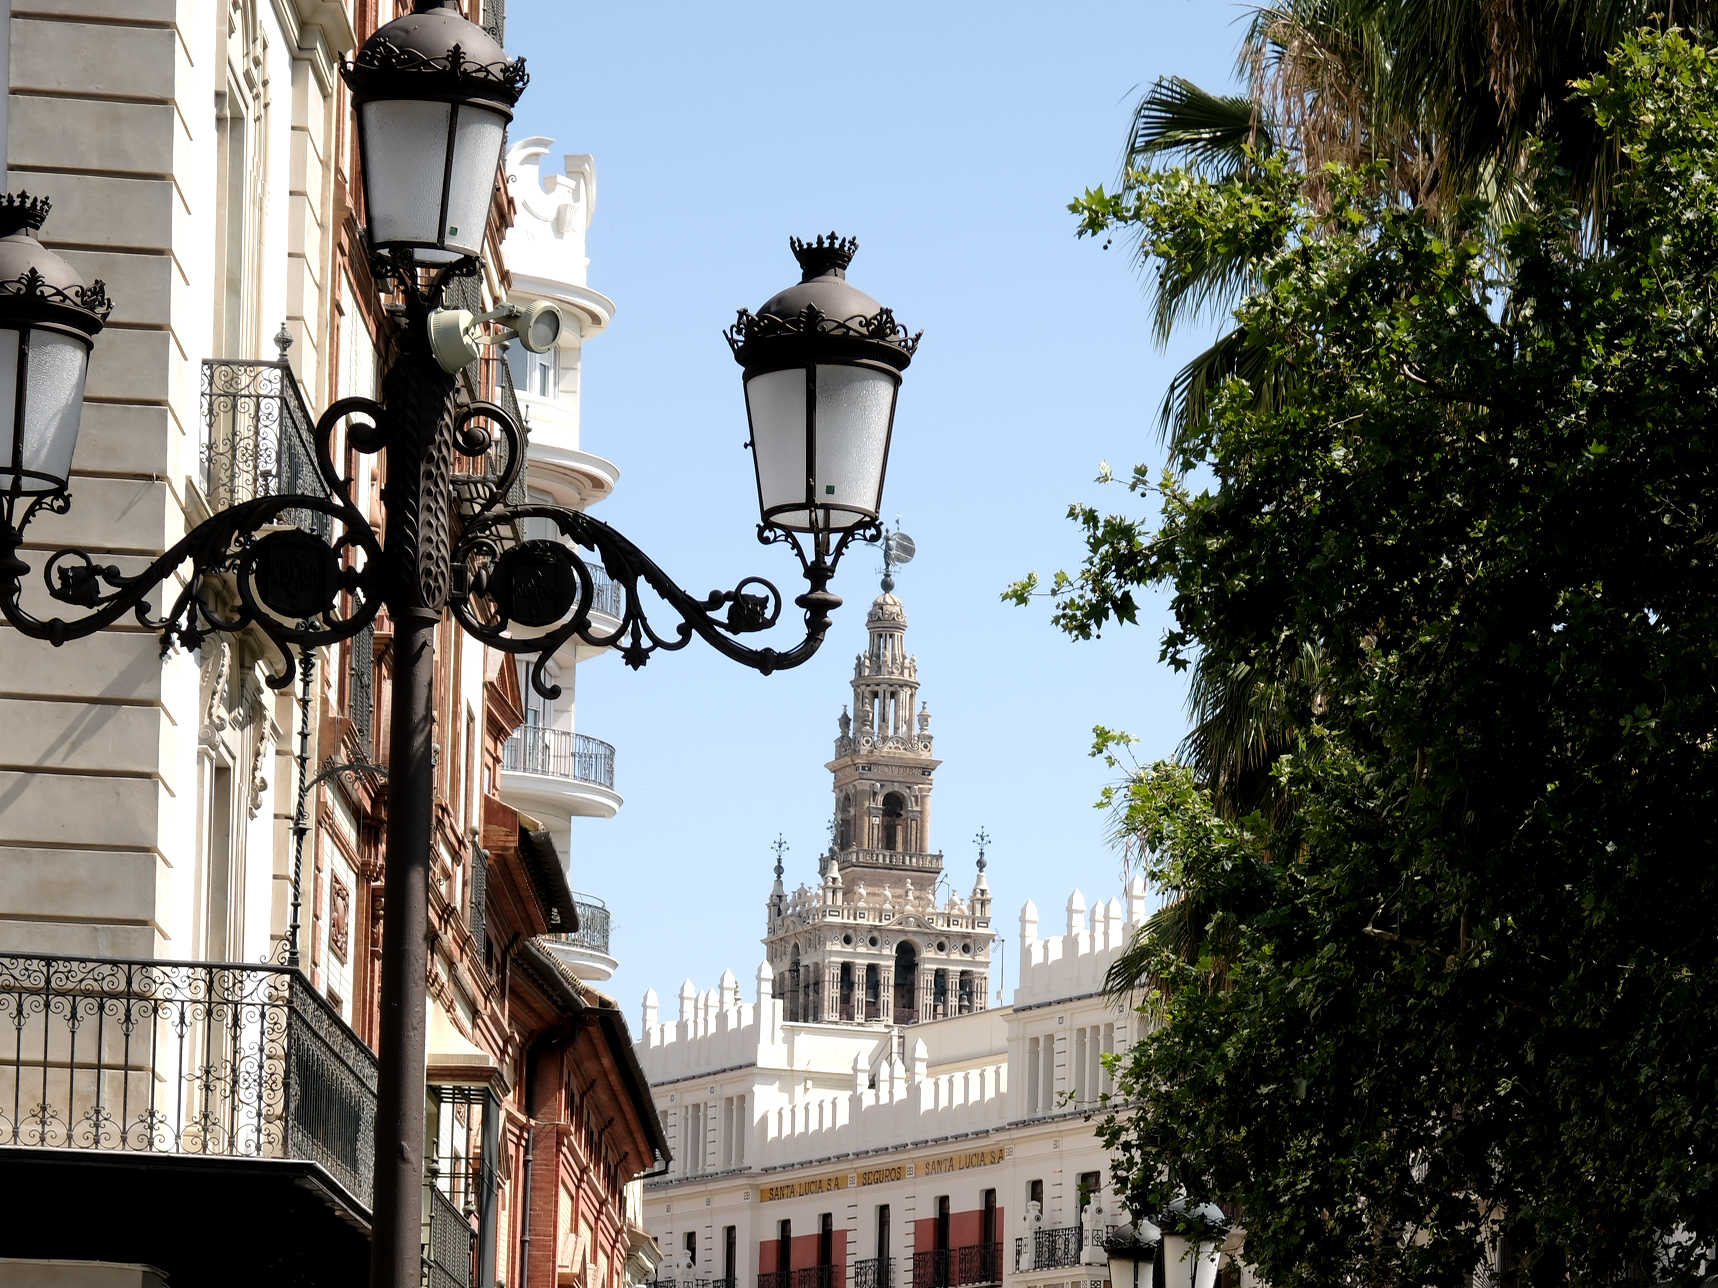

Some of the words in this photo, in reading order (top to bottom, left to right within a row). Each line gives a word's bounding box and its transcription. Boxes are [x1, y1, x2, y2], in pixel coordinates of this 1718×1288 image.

[925, 1157, 955, 1176] SANTA
[958, 1150, 987, 1170] LUCIA
[862, 1166, 902, 1186] SEGUROS
[768, 1184, 795, 1201] SANTA
[798, 1179, 824, 1197] LUCIA
